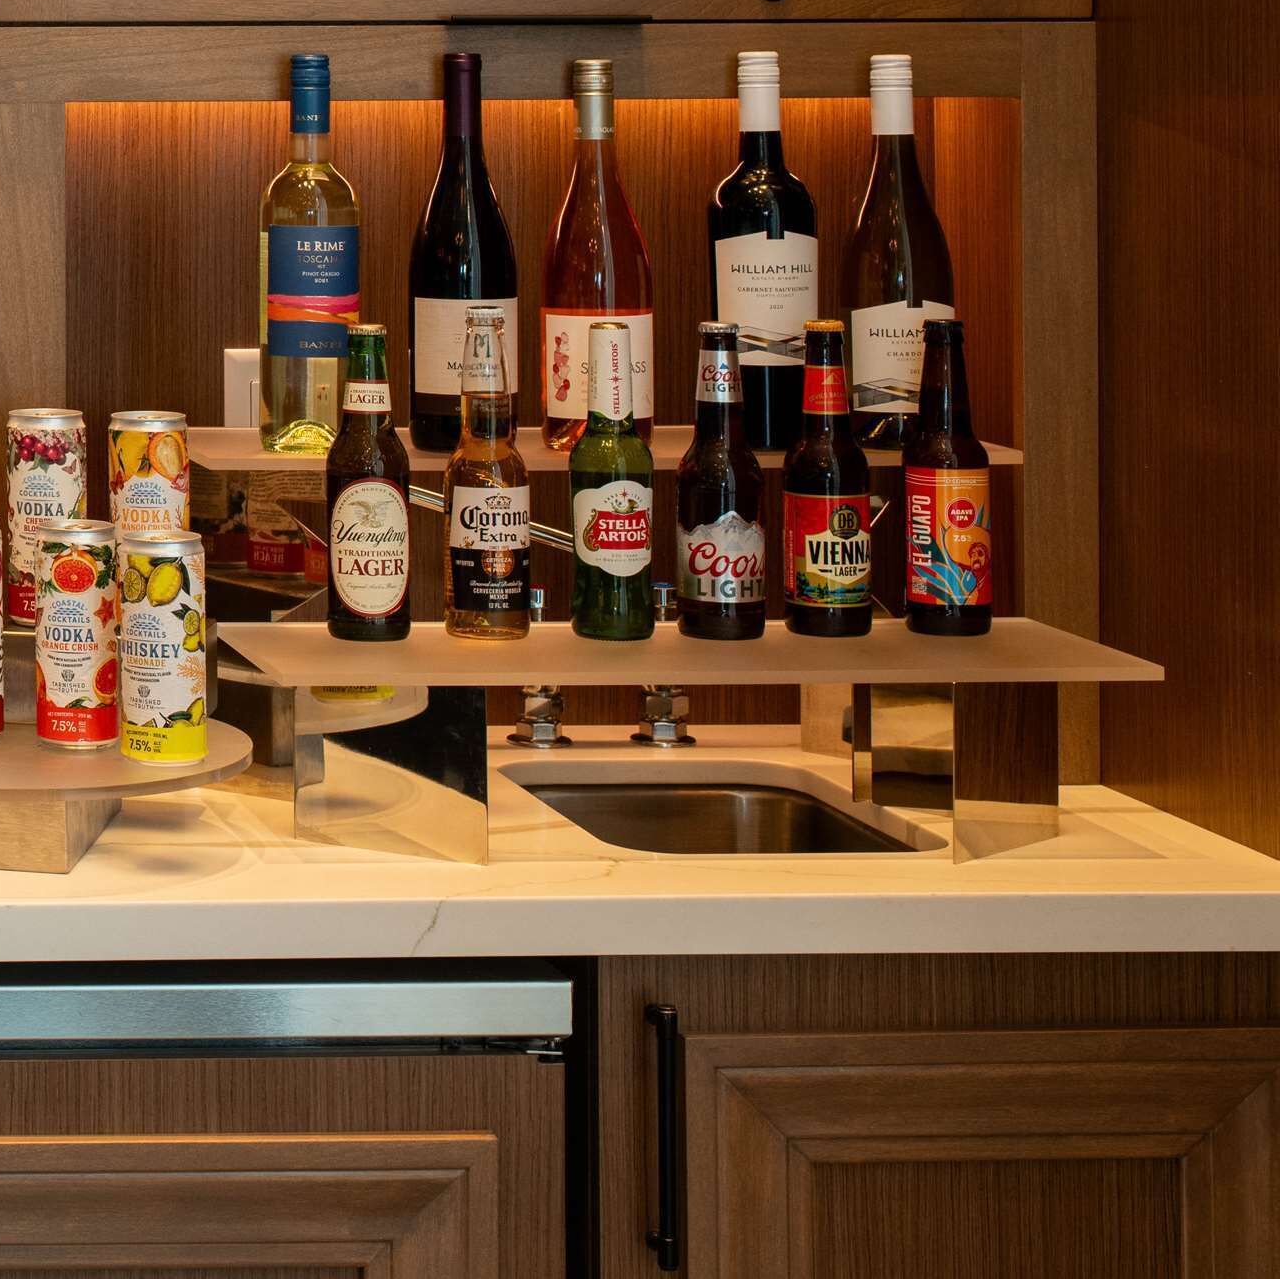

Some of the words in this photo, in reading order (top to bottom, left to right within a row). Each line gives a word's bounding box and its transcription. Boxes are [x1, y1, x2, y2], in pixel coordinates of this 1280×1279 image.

[297, 240, 311, 251] LE
[314, 240, 344, 252] RIME
[730, 263, 786, 274] WILLIAM
[790, 263, 813, 273] HILL
[611, 343, 619, 373] ARTOIS
[701, 363, 740, 383] Coor
[349, 394, 386, 405] LAGER
[612, 385, 621, 415] STELLA
[23, 475, 56, 486] COASTAL
[129, 481, 162, 492] COASTAL
[19, 489, 61, 497] COCKTAILS
[125, 496, 167, 505] COCKTAILS
[16, 501, 65, 516] VODKA
[122, 508, 171, 523] VODKA
[459, 505, 530, 533] Corona
[838, 512, 855, 529] DB
[912, 494, 932, 545] GUAPO
[598, 518, 647, 530] STELLA
[332, 519, 405, 548] Yuengling
[478, 528, 517, 543] Extra
[597, 530, 647, 542] ARTOIS
[343, 548, 401, 558] TRADITIONAL
[808, 539, 871, 565] VIENNA
[912, 551, 932, 567] EL
[336, 557, 405, 577] LAGER
[834, 566, 858, 577] LAGER
[51, 599, 86, 611] COASTAL
[47, 615, 90, 624] COCKTAILS
[129, 613, 161, 625] COASTAL
[44, 626, 94, 643] VODKA
[126, 629, 167, 639] COCKTAILS
[41, 641, 70, 651] ORANGE
[71, 642, 99, 652] CRUSH
[126, 656, 166, 667] LEMONADE
[52, 681, 86, 689] TARNISHED
[129, 697, 162, 706] TARNISHED
[51, 719, 77, 733] 7.5%
[129, 738, 152, 753] 7.5%
